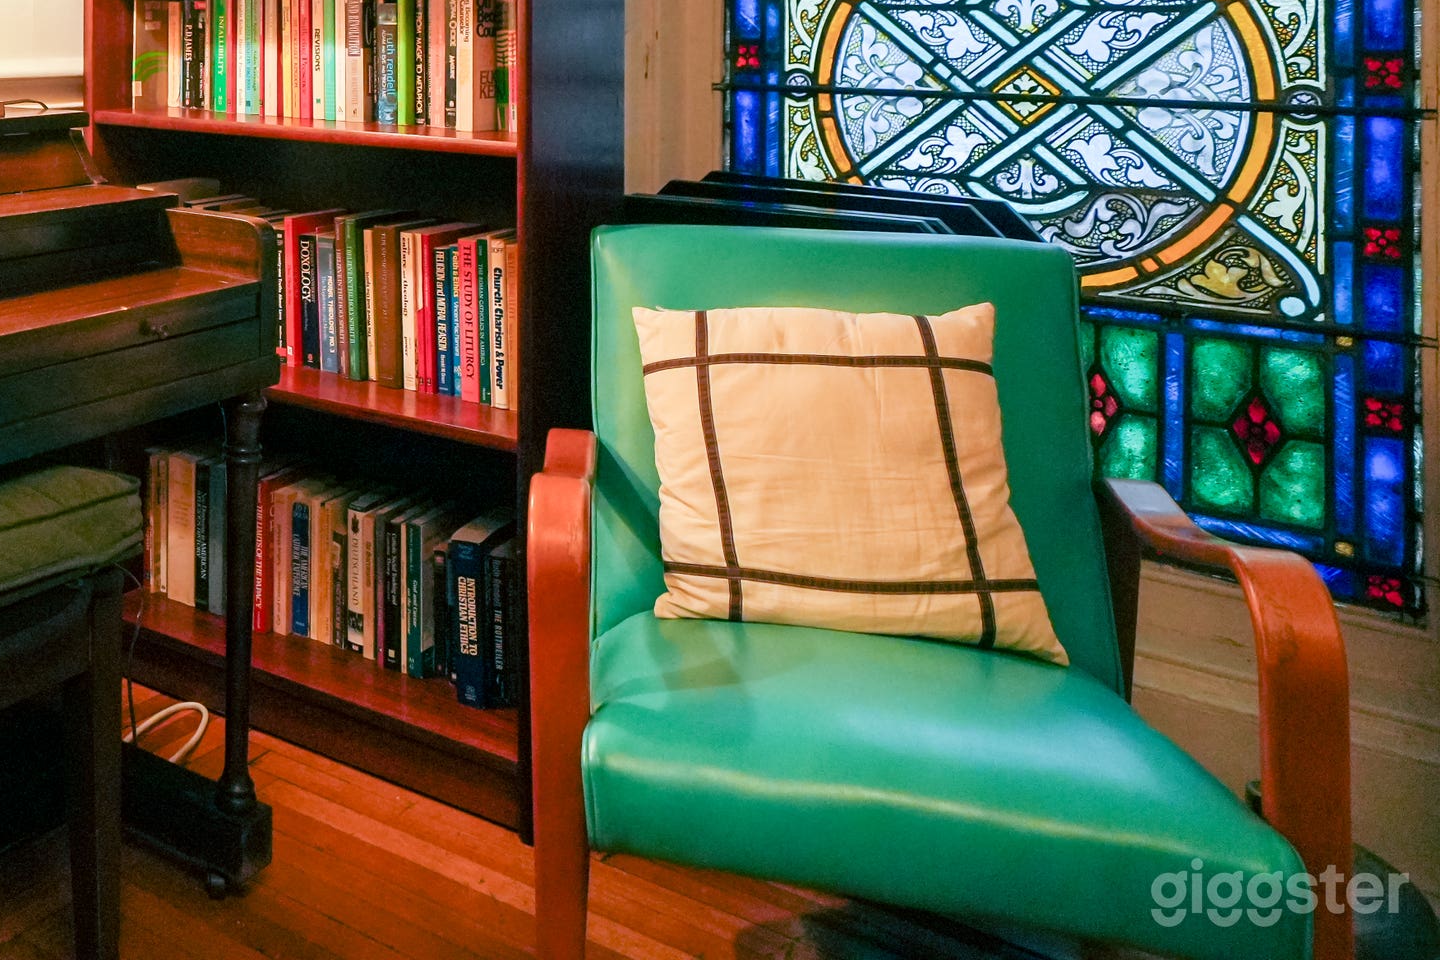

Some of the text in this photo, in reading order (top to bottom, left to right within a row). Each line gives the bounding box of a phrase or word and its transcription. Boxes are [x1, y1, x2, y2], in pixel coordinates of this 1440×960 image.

[348, 15, 361, 57] REVOLUTION
[463, 7, 471, 43] Becoming
[386, 33, 397, 95] ruth rendell
[415, 64, 422, 74] TO
[415, 75, 423, 114] METAPHOR
[300, 240, 311, 302] DOXOLOGY
[493, 267, 504, 306] Church:
[435, 251, 447, 351] RELIGION and MORAL REASON
[463, 245, 475, 380] THE STUDY OF LITURGY
[494, 308, 504, 349] Charism
[495, 359, 504, 389] Power
[256, 548, 263, 559] OF
[351, 538, 360, 606] DEUTSCHLAND
[255, 576, 263, 608] PAPACY
[457, 576, 469, 654] CHRISTIAN ETHICS
[465, 577, 478, 656] INTRODUCTION TO
[494, 609, 503, 623] THE
[494, 624, 504, 670] ROTTWEILER
